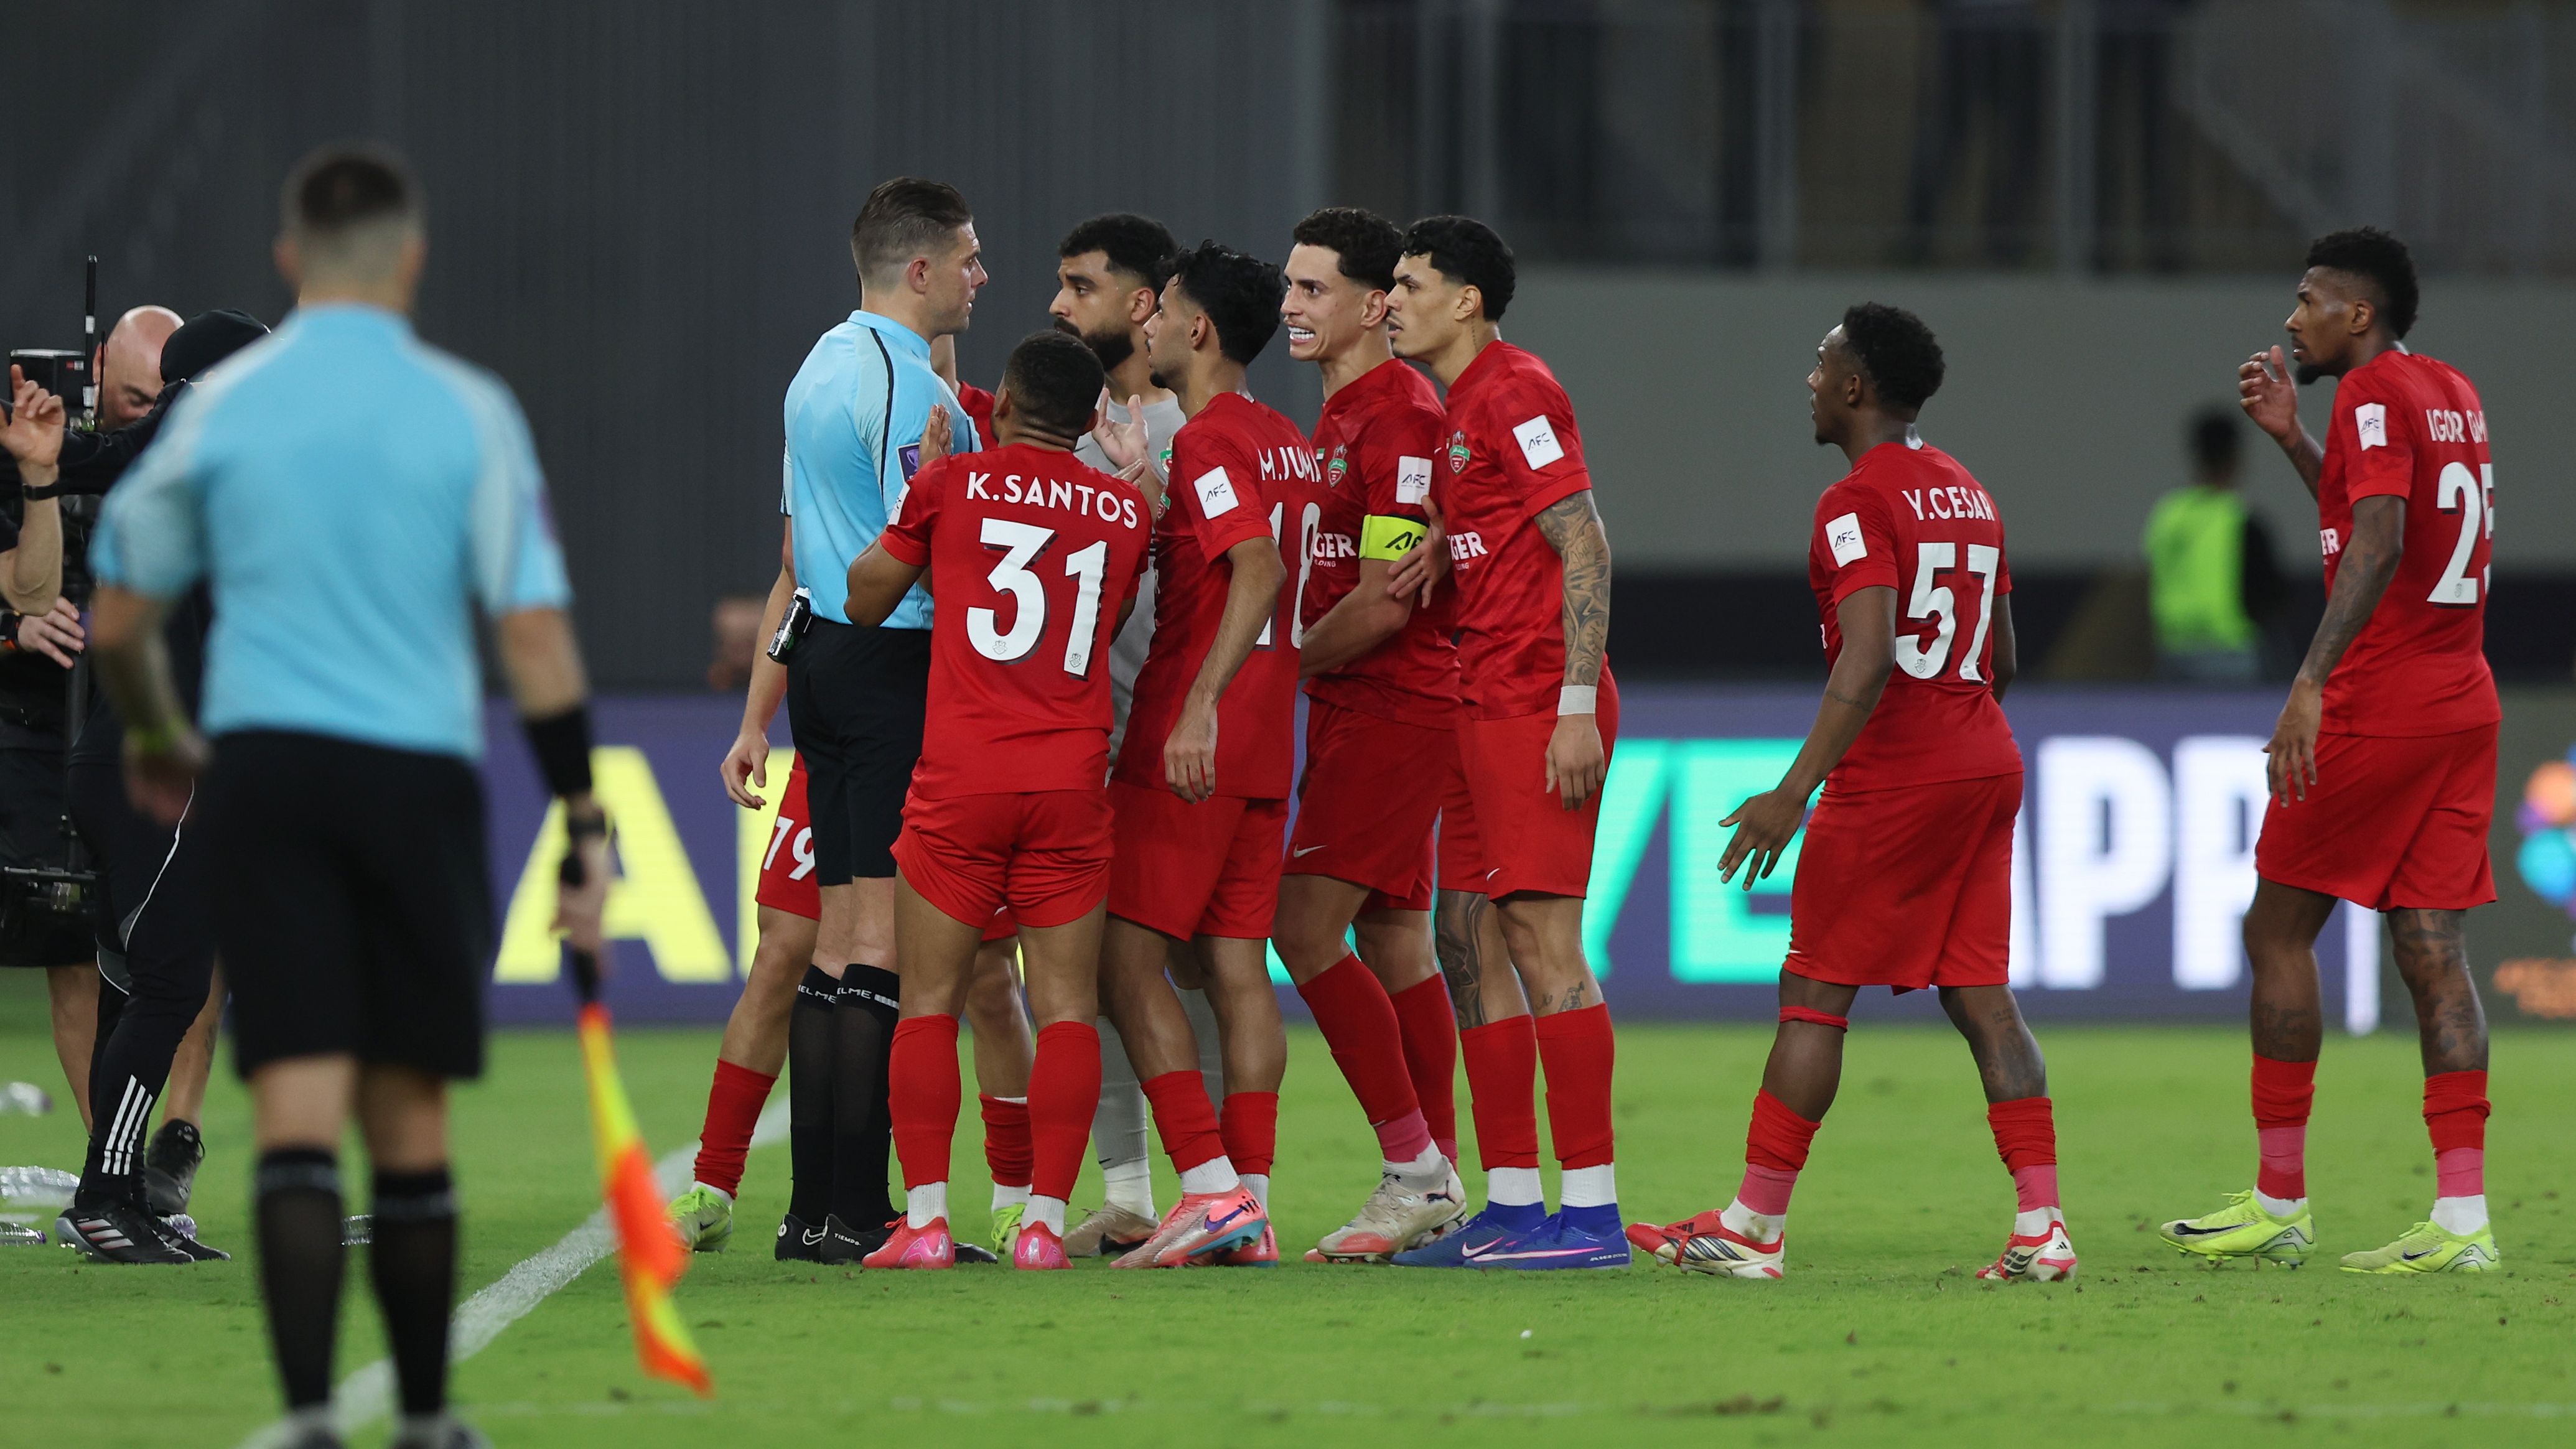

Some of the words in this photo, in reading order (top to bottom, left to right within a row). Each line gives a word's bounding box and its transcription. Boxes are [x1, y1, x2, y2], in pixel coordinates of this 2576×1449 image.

[2425, 409, 2466, 443] IGOR
[1528, 432, 1551, 451] AFC
[1205, 483, 1227, 503] AFC
[1401, 473, 1426, 486] AFC
[966, 471, 1138, 529] K.SANTOS
[1902, 486, 1995, 521] Y.CESAR
[1312, 533, 1357, 558] GER
[1384, 531, 1424, 551] AF
[1447, 531, 1488, 561] GER
[1834, 530, 1856, 548] AFC
[966, 517, 1108, 677] 31
[1895, 542, 2000, 681] 57
[763, 815, 816, 881] 19
